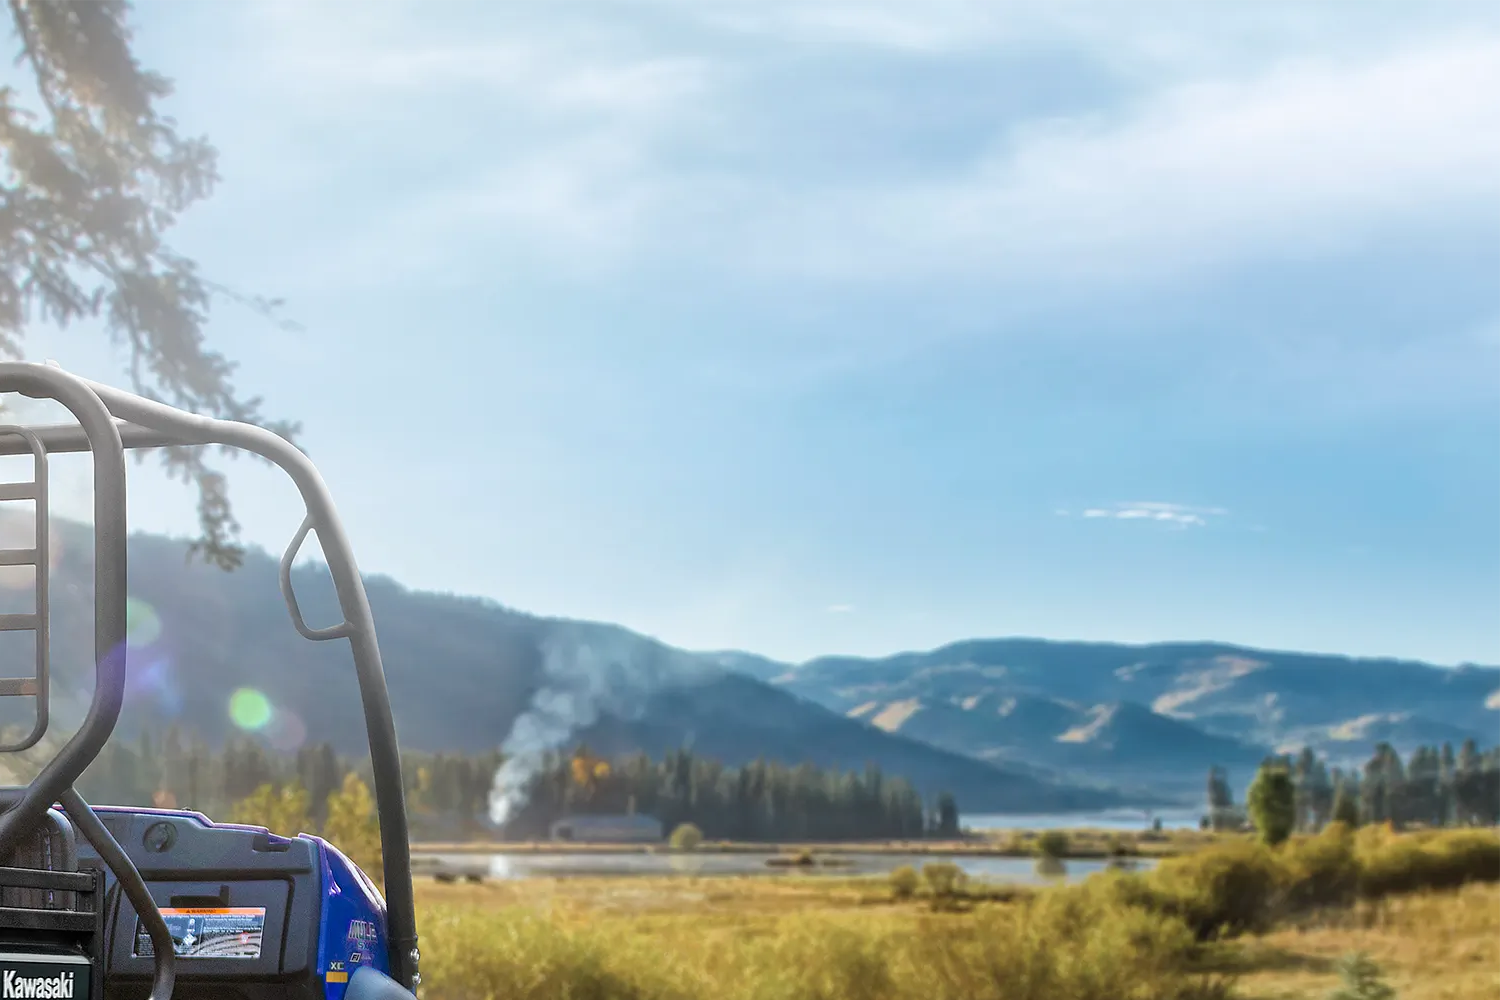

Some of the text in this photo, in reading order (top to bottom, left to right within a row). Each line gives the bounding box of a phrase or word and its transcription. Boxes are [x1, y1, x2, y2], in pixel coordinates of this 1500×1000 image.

[348, 919, 377, 941] MULE
[330, 961, 345, 970] XC
[2, 970, 74, 999] Kawasaki
